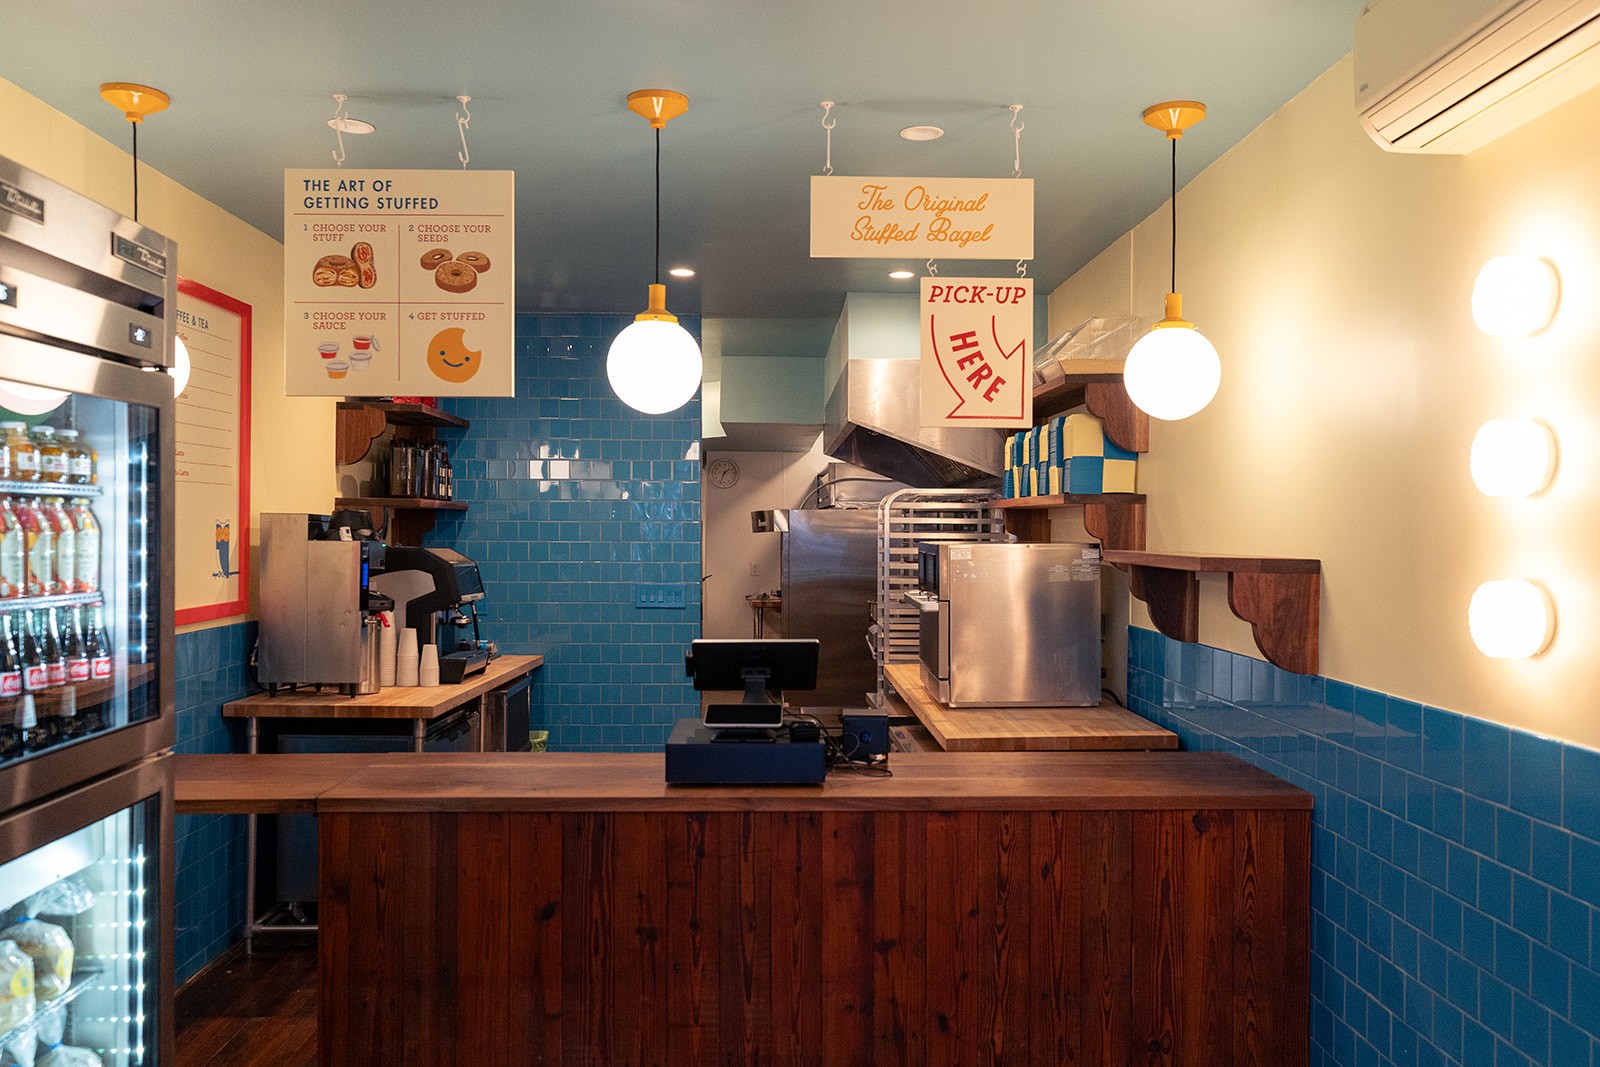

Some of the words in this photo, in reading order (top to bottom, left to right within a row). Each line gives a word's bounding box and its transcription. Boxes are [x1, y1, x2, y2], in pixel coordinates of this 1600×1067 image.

[303, 180, 330, 192] THE
[337, 180, 365, 192] ART
[372, 180, 392, 193] OF
[303, 197, 369, 209] GETTING
[377, 198, 439, 210] STUFFED
[858, 185, 895, 211] The
[904, 185, 989, 217] Original
[303, 224, 309, 232] 1
[312, 224, 356, 233] CHOOSE
[359, 224, 387, 233] YOUR
[417, 225, 461, 234] CHOOSE
[463, 225, 492, 234] YOUR
[850, 215, 920, 245] Stuffed
[926, 217, 994, 248] Bagel
[312, 233, 344, 242] STUFF
[417, 234, 449, 242] SEEDS
[927, 285, 1026, 304] PICK-UP
[176, 309, 190, 324] FFEE
[198, 317, 209, 330] TEA
[312, 312, 356, 321] CHOOSE
[359, 312, 387, 321] YOUR
[408, 313, 415, 321] 4
[417, 312, 437, 321] GET
[439, 312, 486, 321] STUFFED
[312, 321, 347, 330] SAUCE
[949, 330, 1007, 403] HERE
